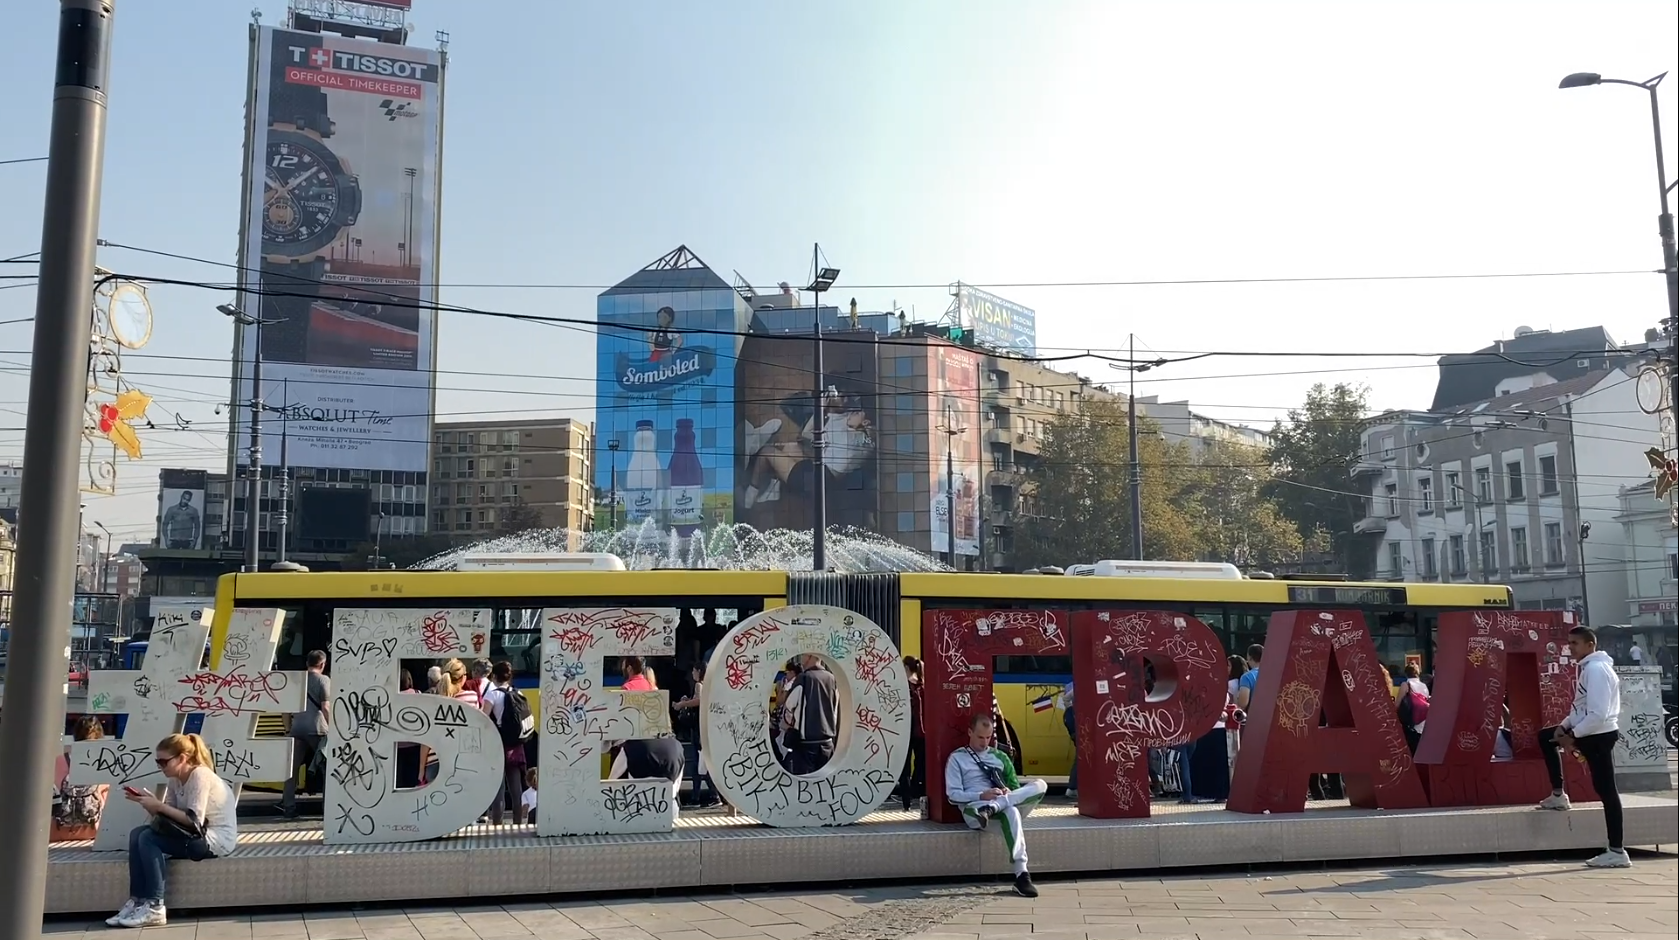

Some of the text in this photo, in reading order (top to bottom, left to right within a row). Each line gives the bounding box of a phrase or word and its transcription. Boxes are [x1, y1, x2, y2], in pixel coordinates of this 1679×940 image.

[288, 45, 428, 79] T TISSOT
[290, 70, 418, 96] OFFICIAL TIMEKEEPER
[271, 154, 299, 169] 12
[972, 297, 1012, 329] VISAN
[317, 396, 354, 404] DISTRIBUTER
[277, 407, 394, 426] ABSOLUT Time
[674, 507, 695, 515] Jogurt
[797, 774, 849, 804] BIK
[828, 769, 895, 821] FOUR
